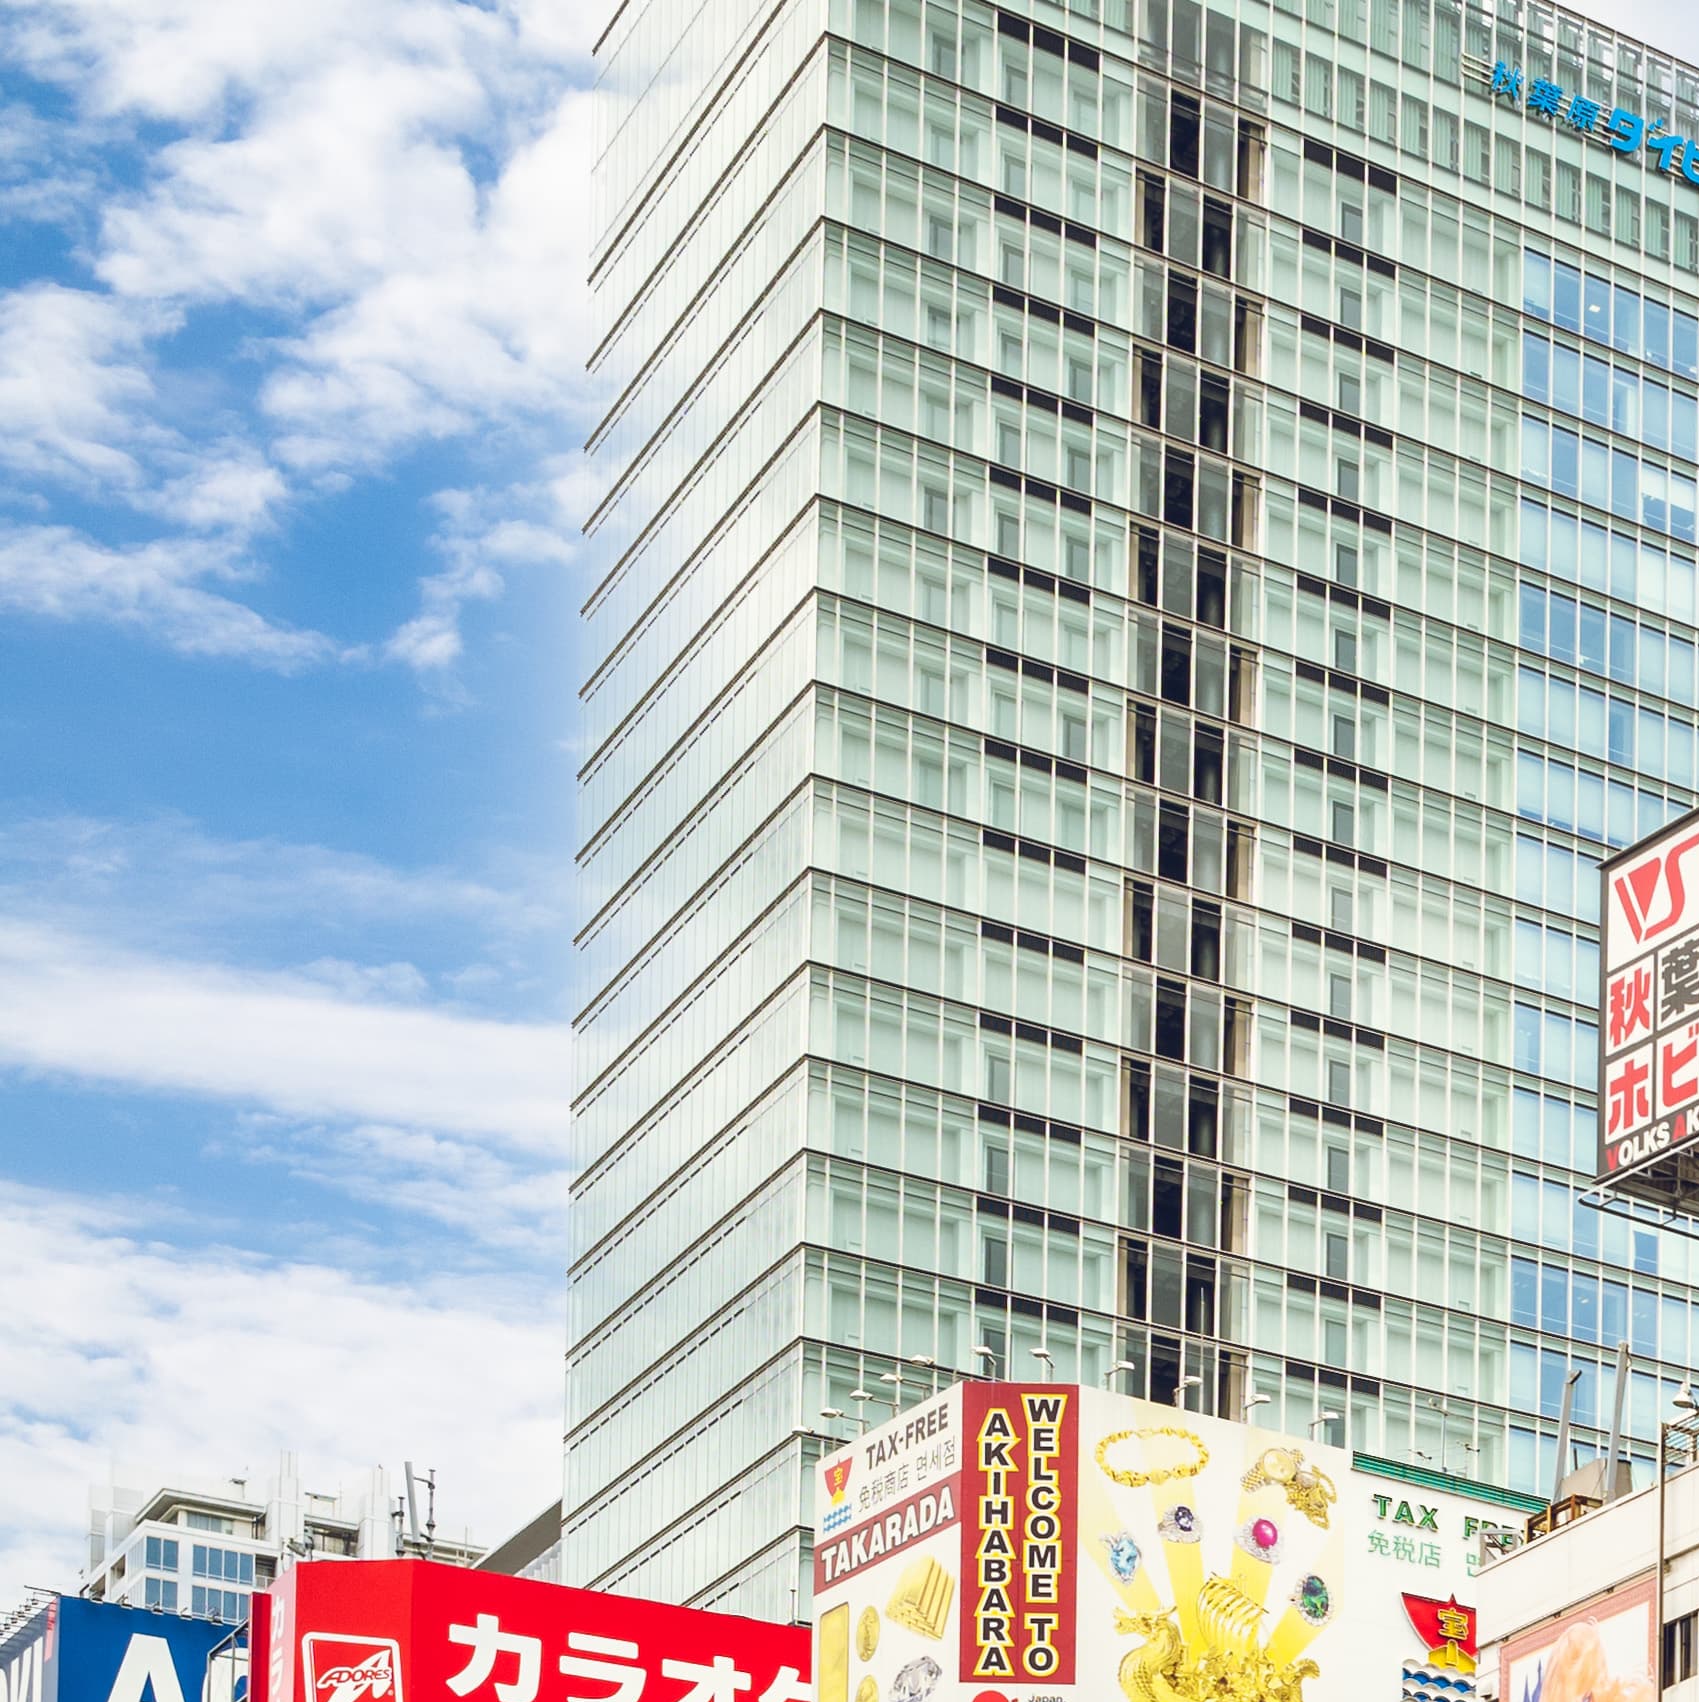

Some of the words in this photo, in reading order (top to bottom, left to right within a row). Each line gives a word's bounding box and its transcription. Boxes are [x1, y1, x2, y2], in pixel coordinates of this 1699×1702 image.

[1606, 1121, 1669, 1172] VOLKS
[866, 1403, 948, 1470] TAX-FREE
[1022, 1395, 1067, 1601] WELCOME
[1373, 1494, 1439, 1532] TAX
[821, 1485, 955, 1583] TAKARADA
[979, 1409, 1017, 1675] AKIHABARA
[1368, 1529, 1441, 1568] 免税店
[1027, 1614, 1058, 1676] TO
[1437, 1607, 1468, 1641] 宝
